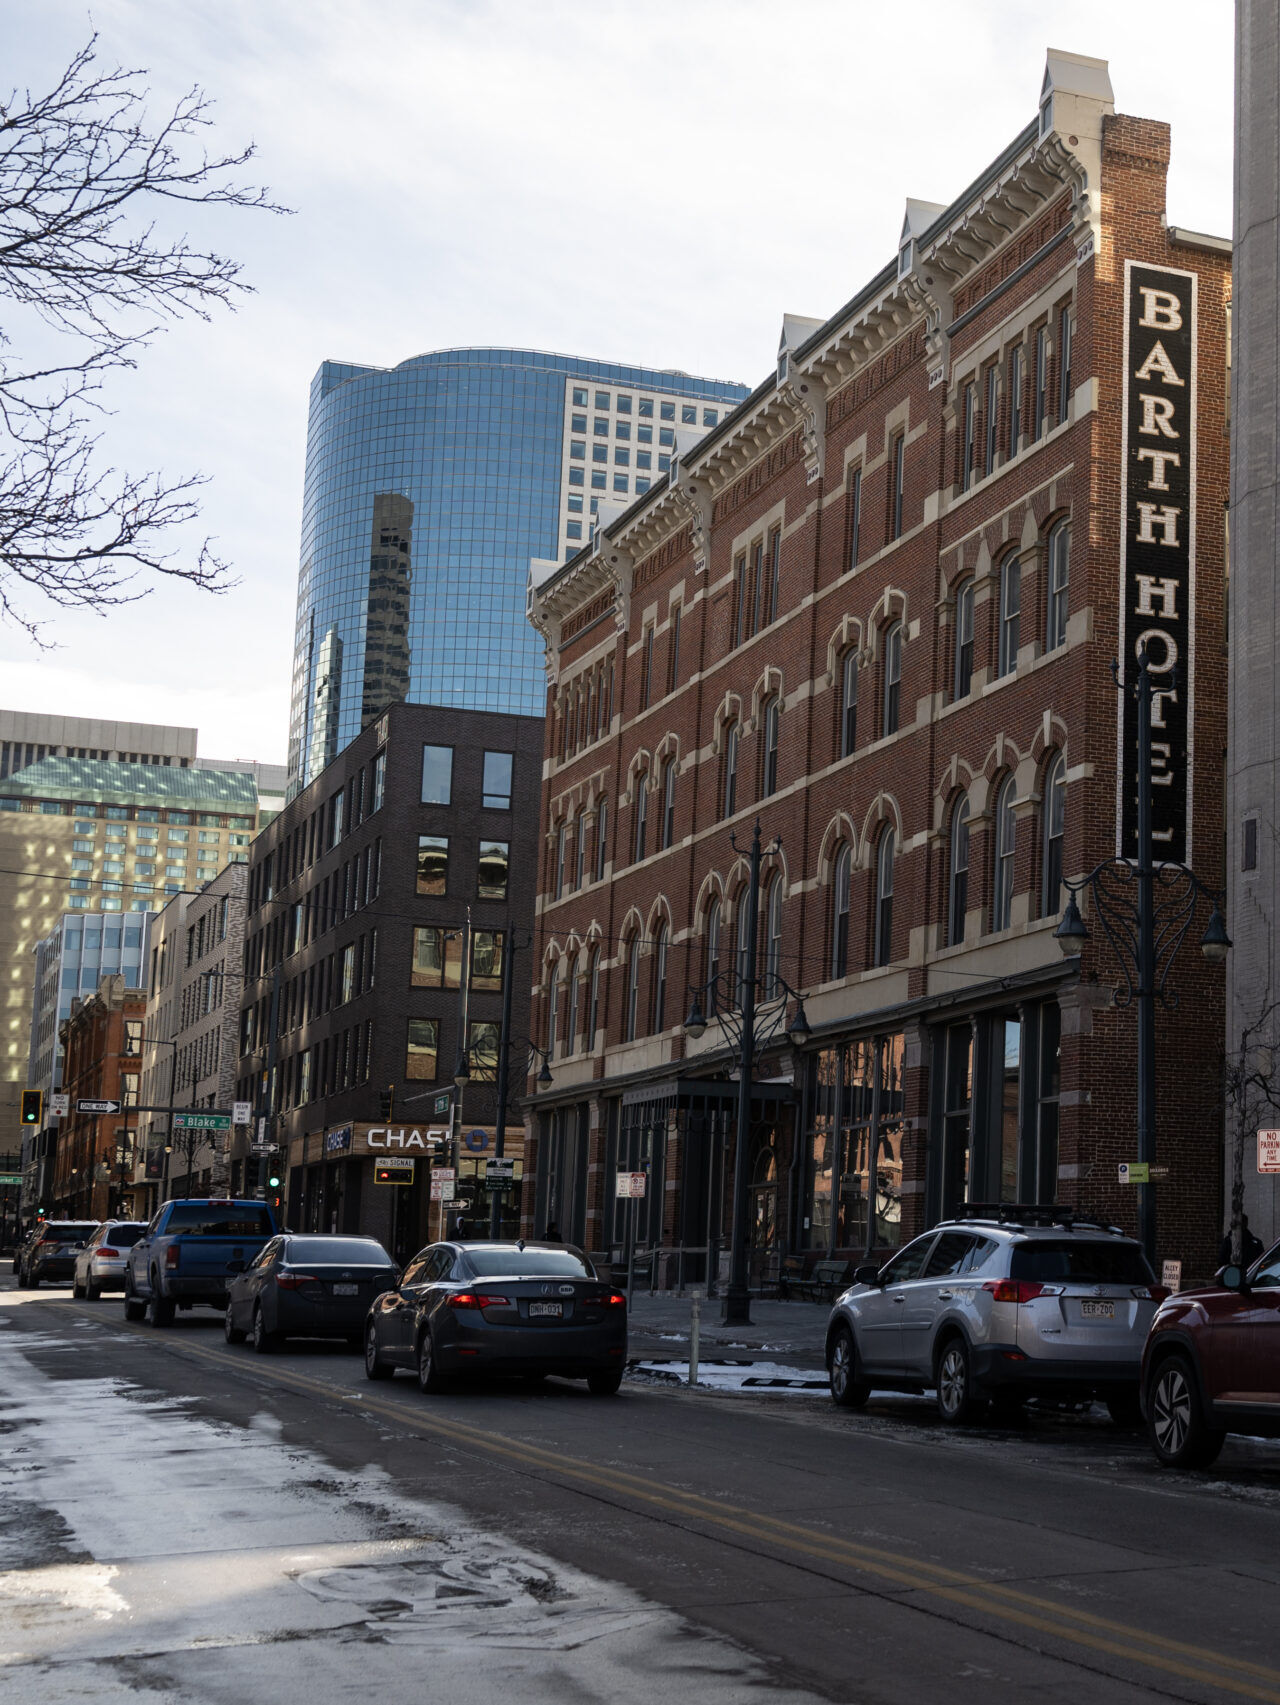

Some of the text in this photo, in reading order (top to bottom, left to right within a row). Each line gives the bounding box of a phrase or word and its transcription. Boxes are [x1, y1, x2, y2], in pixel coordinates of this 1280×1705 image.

[1135, 286, 1185, 549] BARTH
[187, 1117, 216, 1127] Blake
[327, 1129, 344, 1152] CHASE
[1266, 1132, 1277, 1140] NO
[1163, 1272, 1179, 1280] CLOSED
